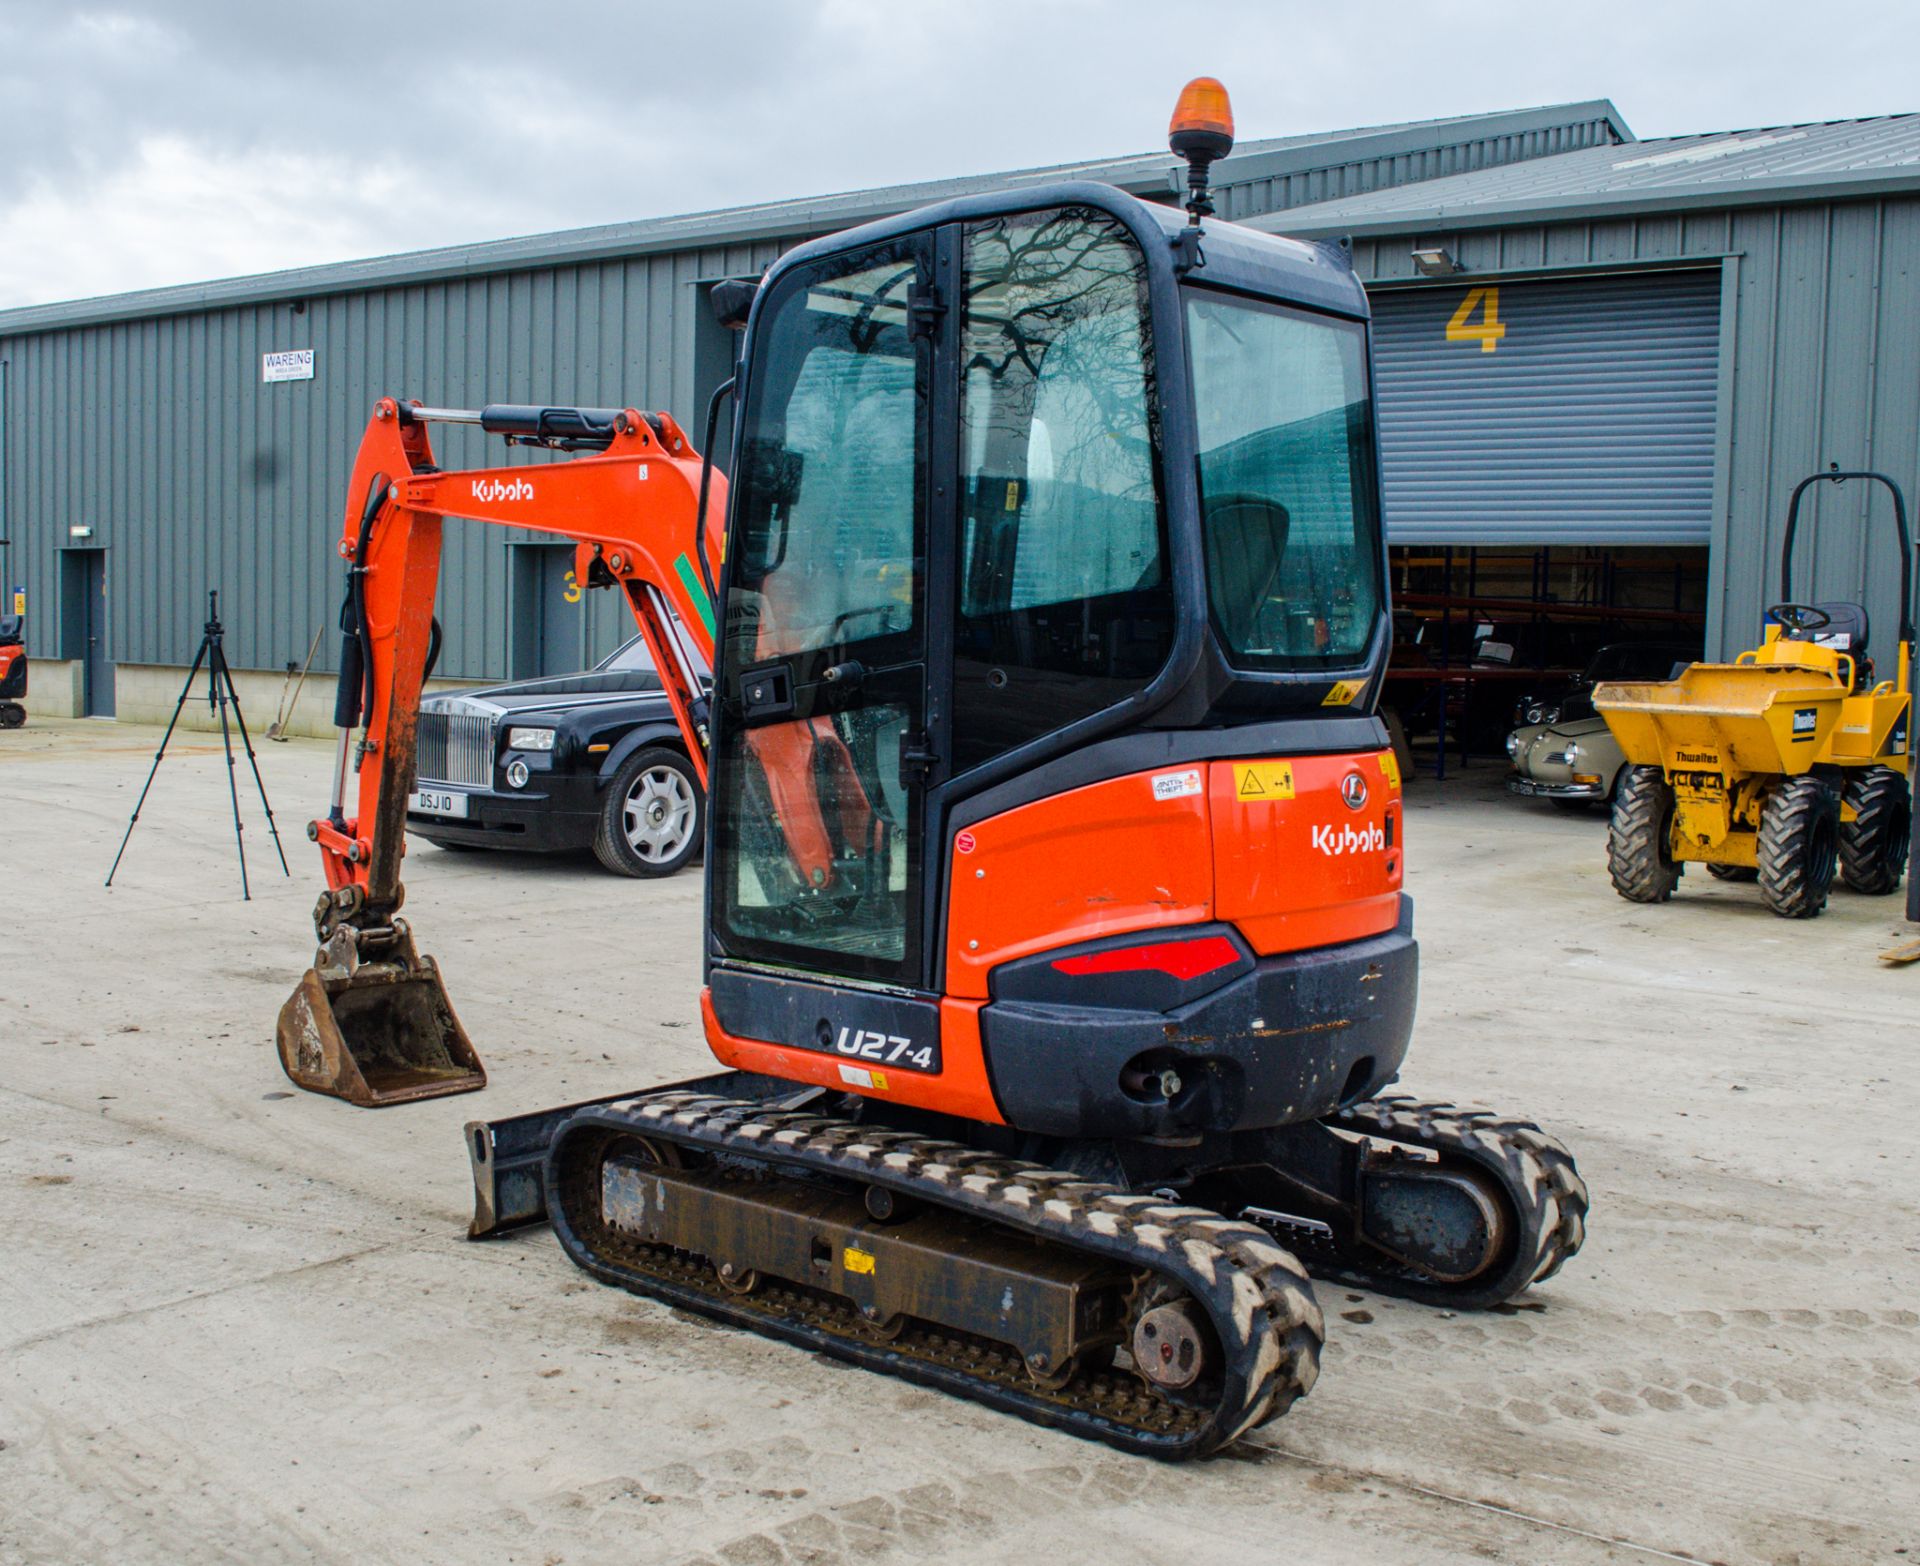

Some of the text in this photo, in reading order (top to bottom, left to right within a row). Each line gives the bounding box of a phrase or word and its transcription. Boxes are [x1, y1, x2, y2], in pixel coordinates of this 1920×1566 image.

[1446, 287, 1506, 353] 4
[266, 351, 312, 367] WAREING
[472, 478, 533, 502] Kubota
[563, 571, 581, 603] 3
[1676, 751, 1718, 764] Thwaites
[1156, 785, 1183, 795] THEFT
[1312, 821, 1385, 856] Kubota
[837, 1026, 933, 1069] U27-4
